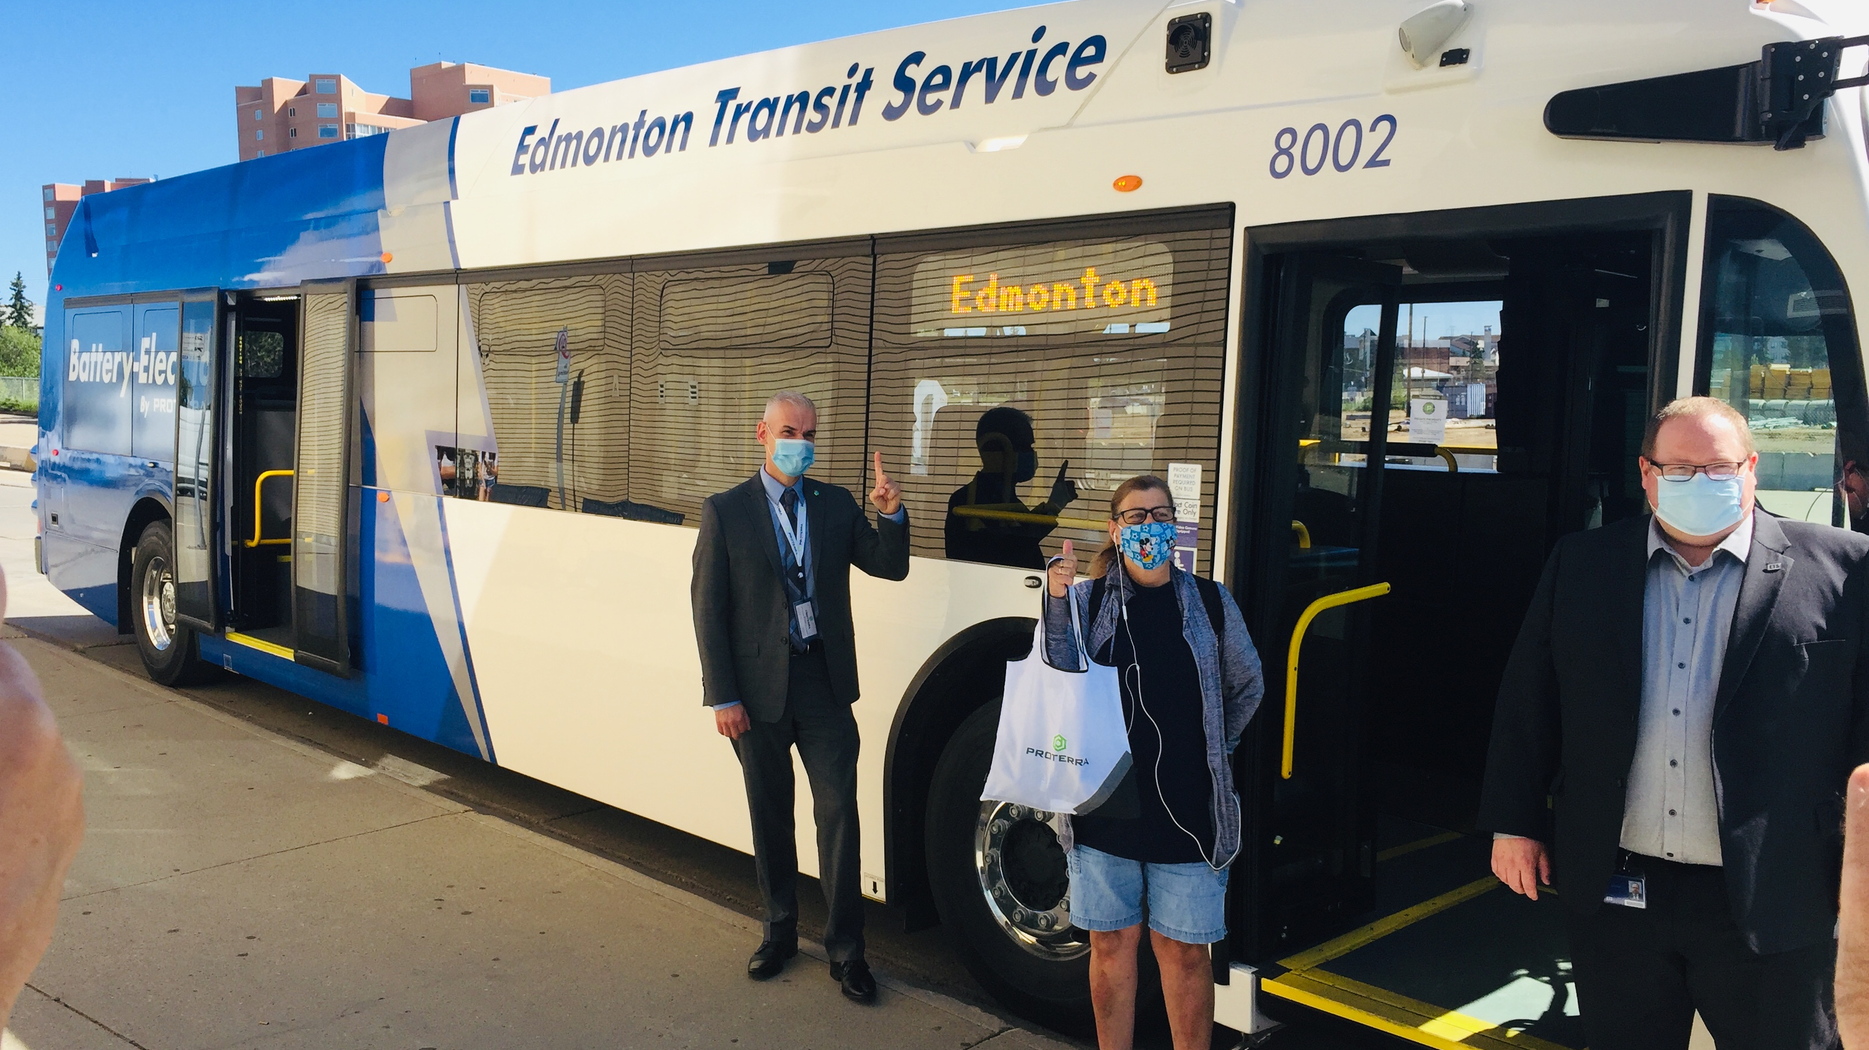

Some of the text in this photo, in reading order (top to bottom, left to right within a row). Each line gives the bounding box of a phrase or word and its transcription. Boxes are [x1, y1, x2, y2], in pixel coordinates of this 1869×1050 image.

[510, 25, 1107, 177] Edmonton Transit Service
[1269, 113, 1398, 180] 8002
[951, 266, 1159, 314] Edmonton
[68, 332, 178, 398] Battery-Elec
[140, 395, 150, 418] By
[1182, 508, 1197, 517] Only
[1183, 501, 1198, 509] Coin
[1026, 747, 1089, 767] PROTERRA
